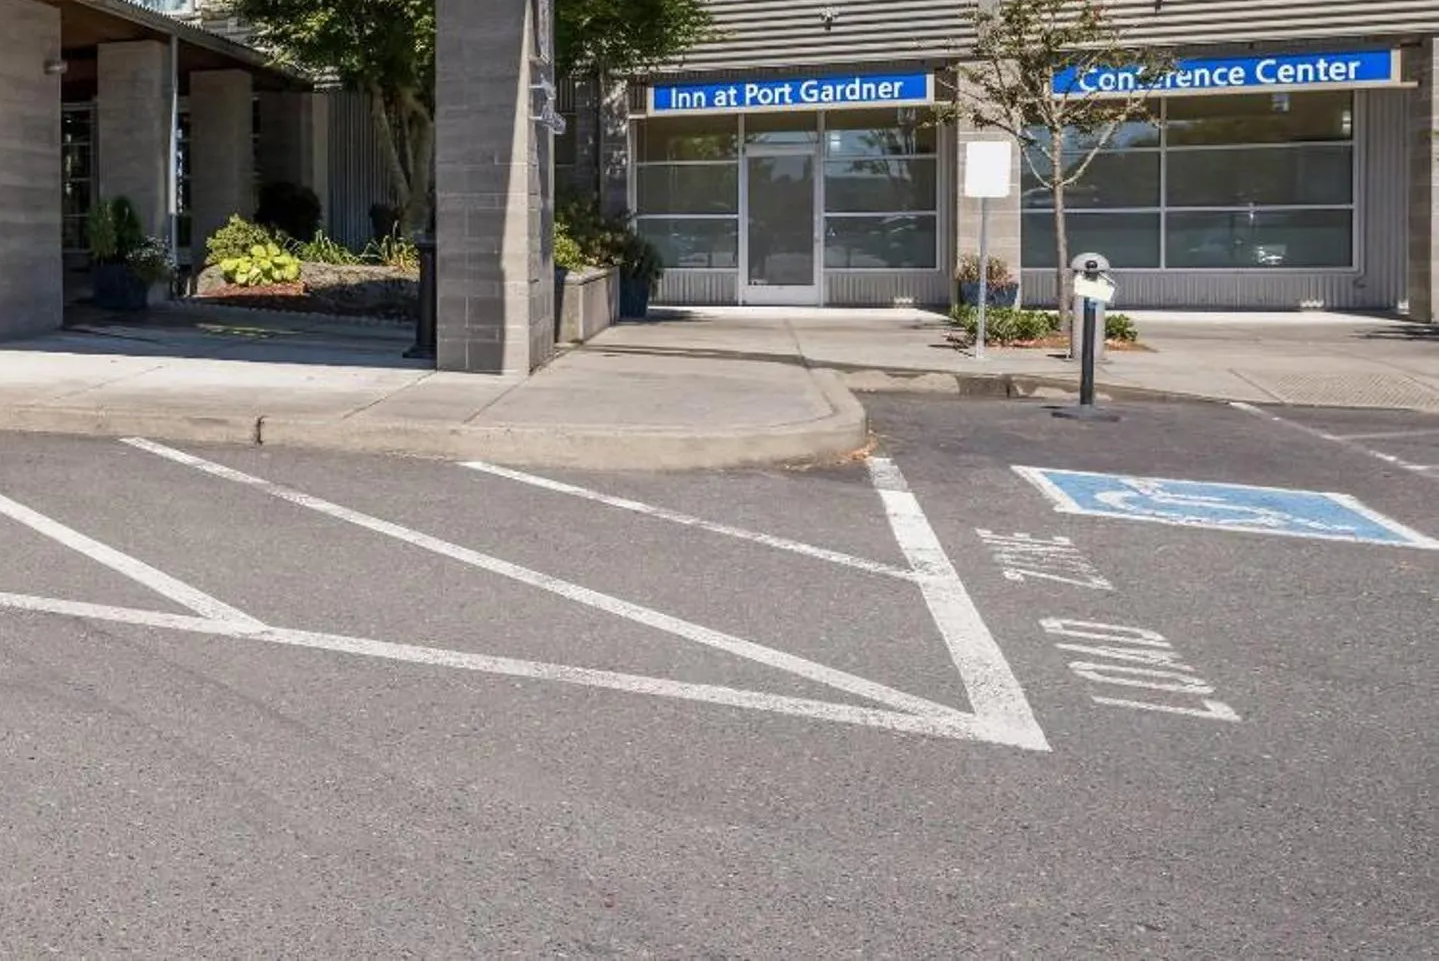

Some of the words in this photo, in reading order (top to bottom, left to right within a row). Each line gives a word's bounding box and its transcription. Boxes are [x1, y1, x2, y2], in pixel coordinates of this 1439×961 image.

[1079, 64, 1246, 91] Conrence
[1256, 58, 1361, 83] Center
[671, 87, 706, 108] Inn
[714, 85, 738, 107] at
[745, 83, 792, 105] Port
[801, 76, 904, 102] Gardner
